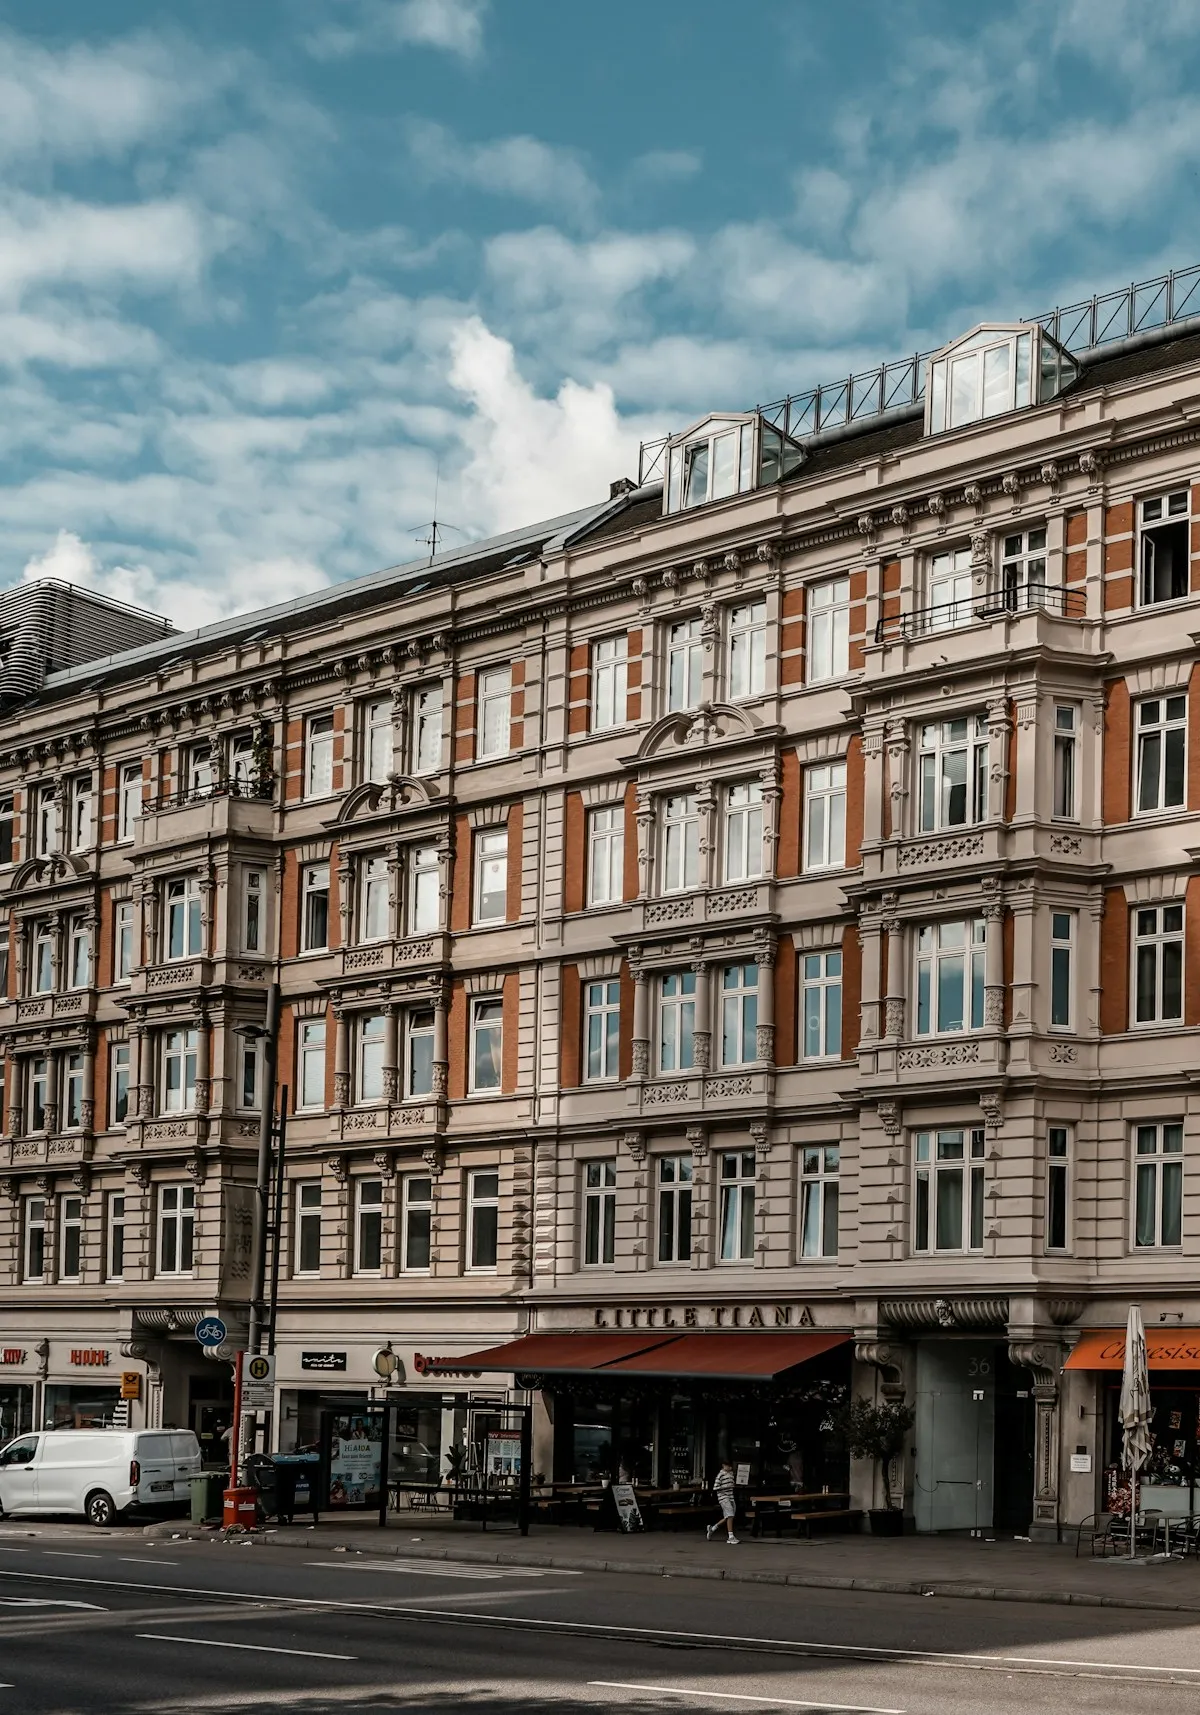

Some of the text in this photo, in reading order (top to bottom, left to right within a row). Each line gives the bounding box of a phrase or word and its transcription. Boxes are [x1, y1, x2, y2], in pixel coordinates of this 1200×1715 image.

[595, 1306, 815, 1327] LITTLE TIANA
[254, 1362, 265, 1375] H
[968, 1357, 991, 1374] 36
